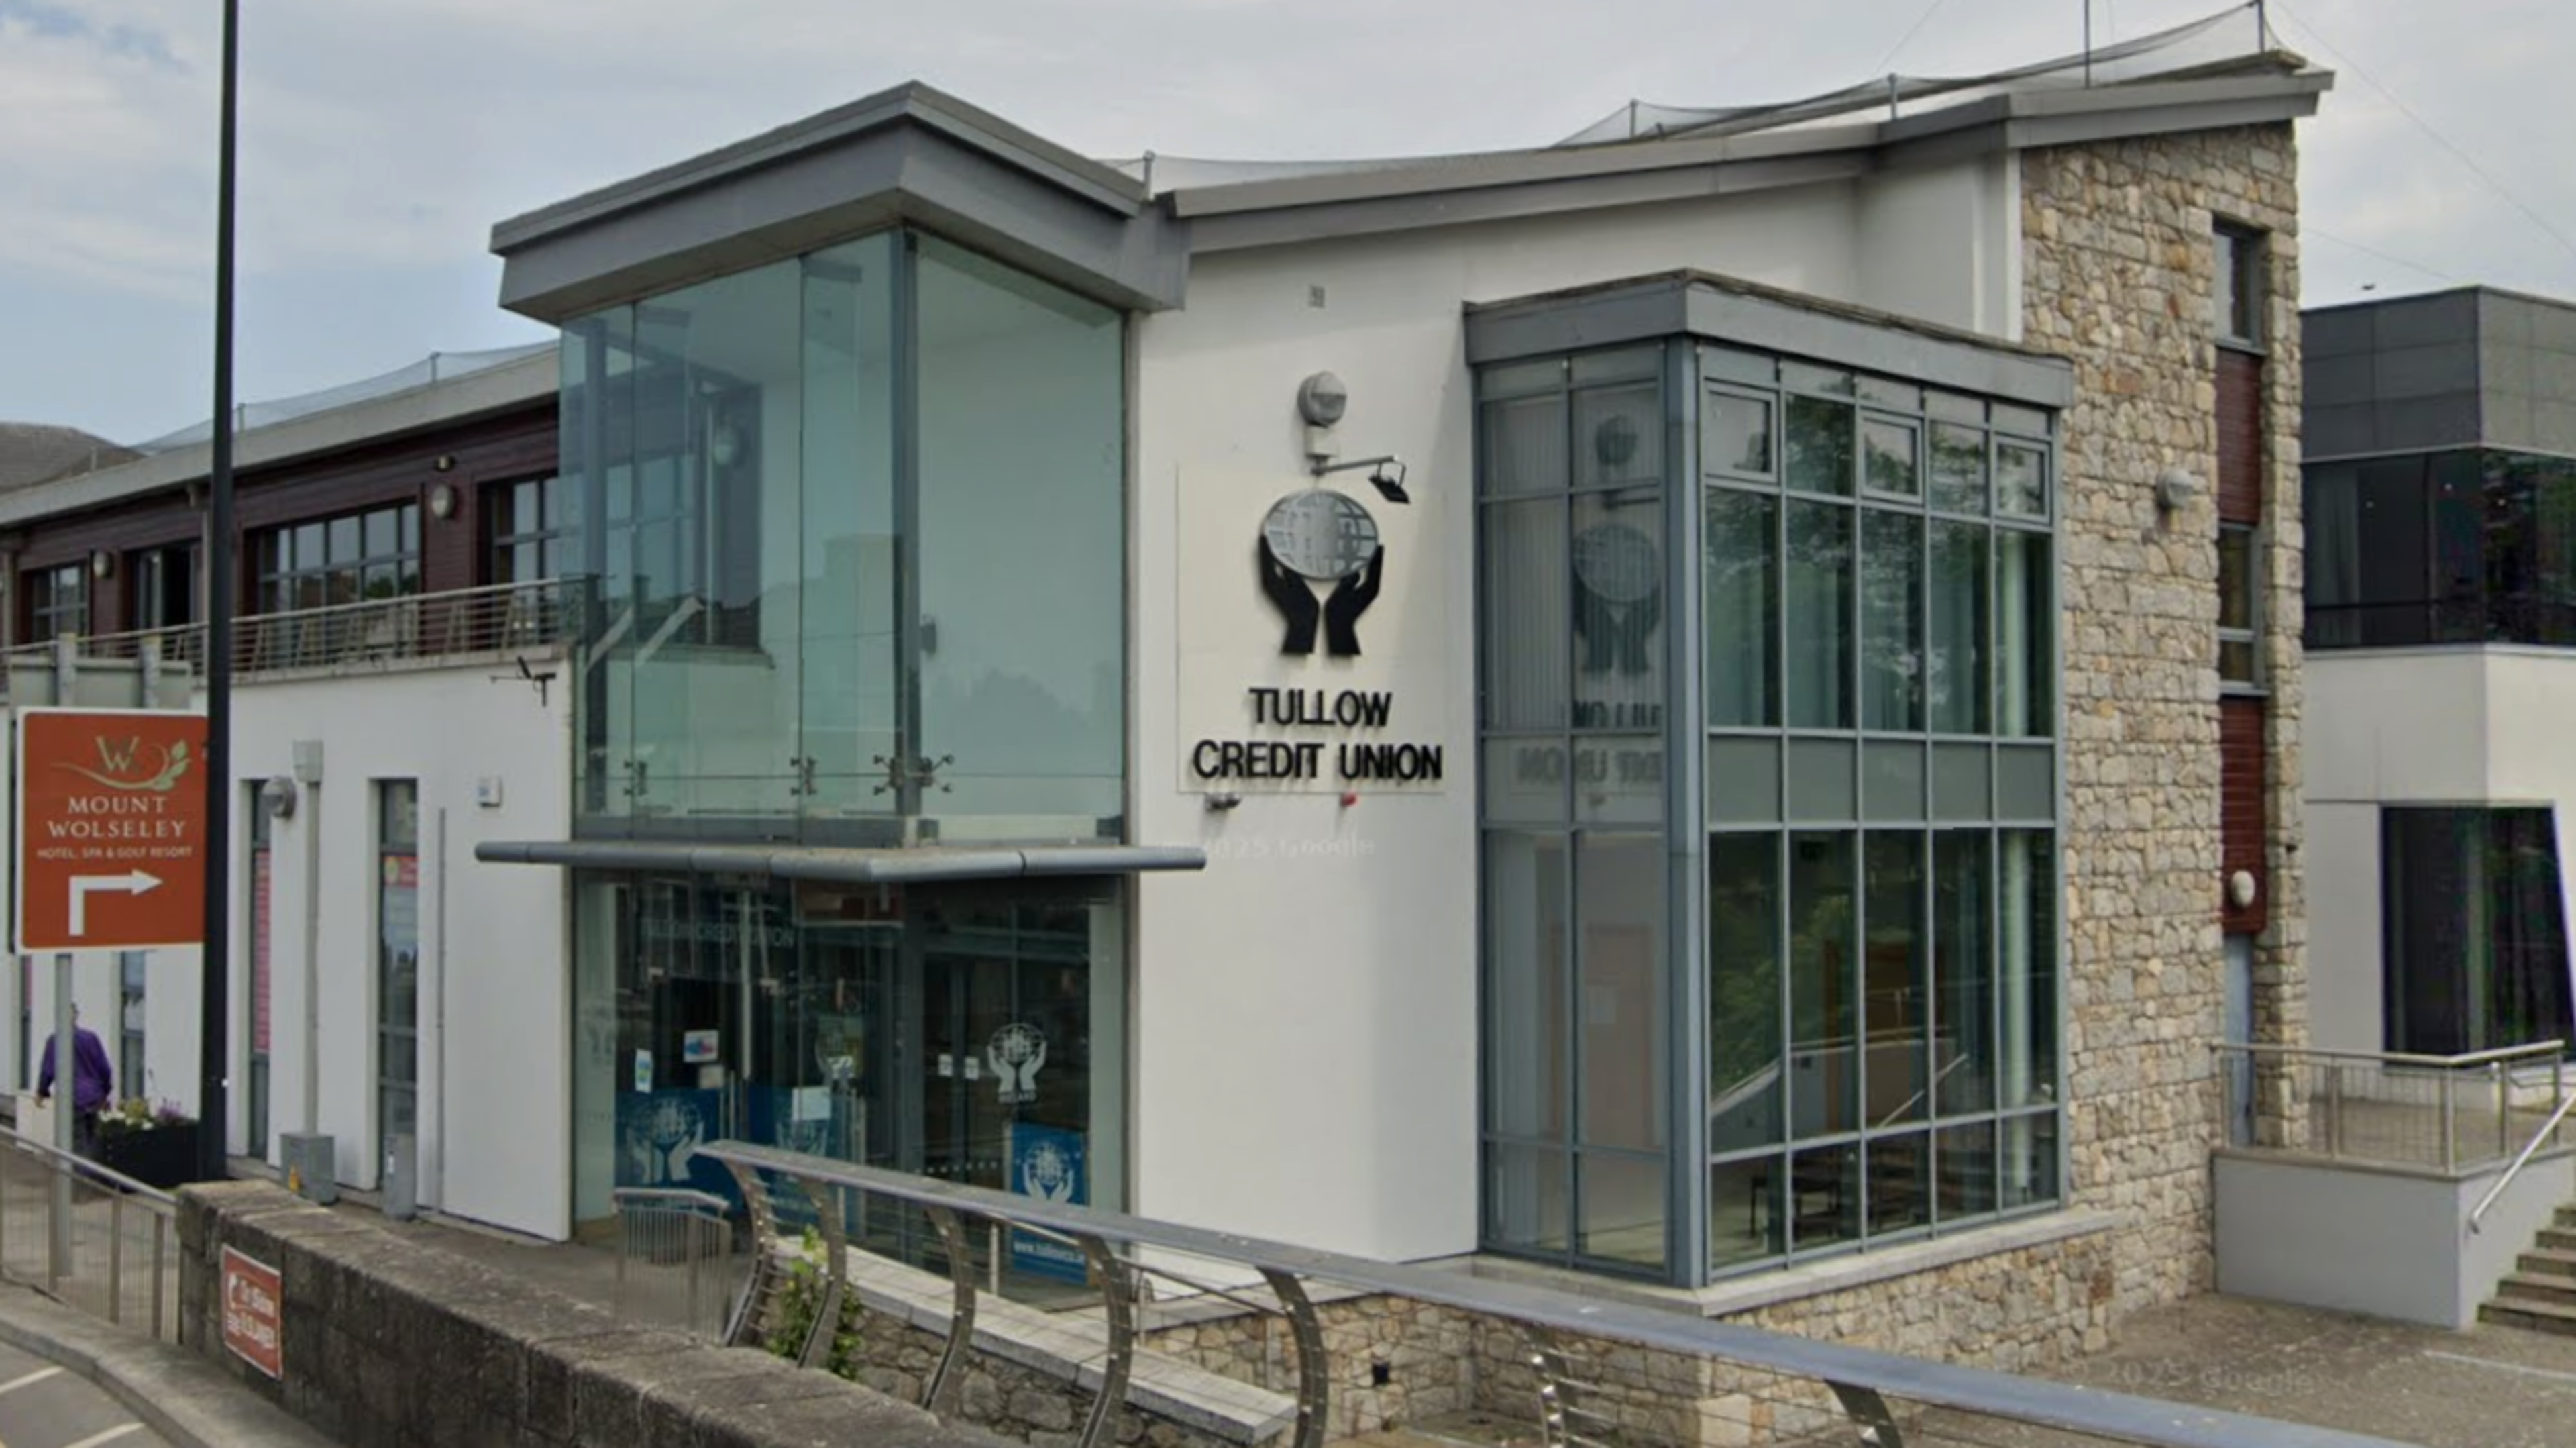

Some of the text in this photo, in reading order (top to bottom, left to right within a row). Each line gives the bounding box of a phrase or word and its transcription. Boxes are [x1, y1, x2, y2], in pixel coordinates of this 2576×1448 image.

[1248, 688, 1392, 727] TULLOW
[1193, 740, 1442, 780] CREDIT UNION
[68, 796, 166, 815] MOUNT
[46, 820, 186, 838] WOLSELEY
[82, 846, 103, 859] SPA
[106, 846, 115, 858] &
[117, 846, 147, 858] GOLF
[150, 845, 193, 858] RESORT
